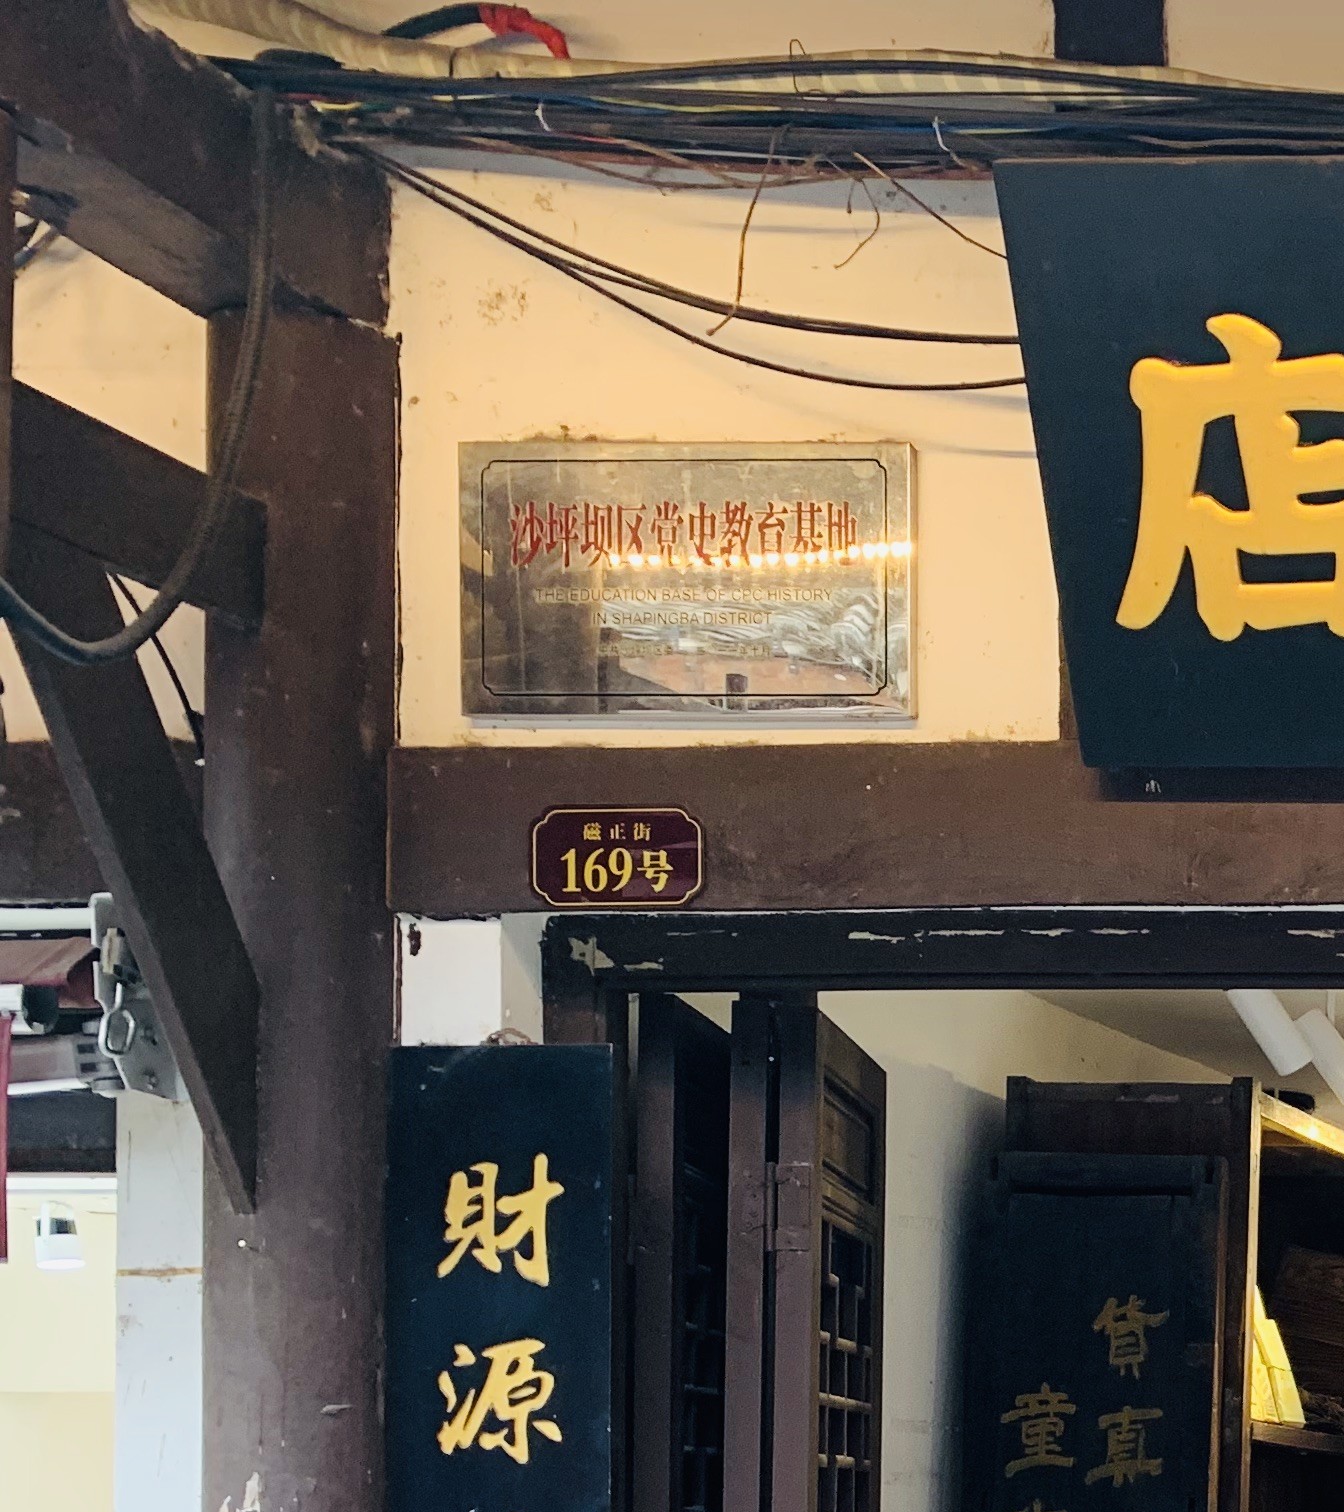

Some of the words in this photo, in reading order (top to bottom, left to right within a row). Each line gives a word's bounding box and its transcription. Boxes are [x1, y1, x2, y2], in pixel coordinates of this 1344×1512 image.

[510, 501, 858, 568] 沙坪坝区党史教育基地
[536, 588, 564, 602] THE
[570, 588, 656, 602] EDUCATION
[662, 588, 700, 602] BASE
[706, 588, 726, 602] OF
[731, 588, 765, 602] CPC
[768, 588, 832, 602] HISTORY
[593, 612, 607, 626] IN
[611, 612, 699, 626] SHAPINGBA
[703, 612, 772, 626] DISTRICT
[559, 847, 674, 893] 169号
